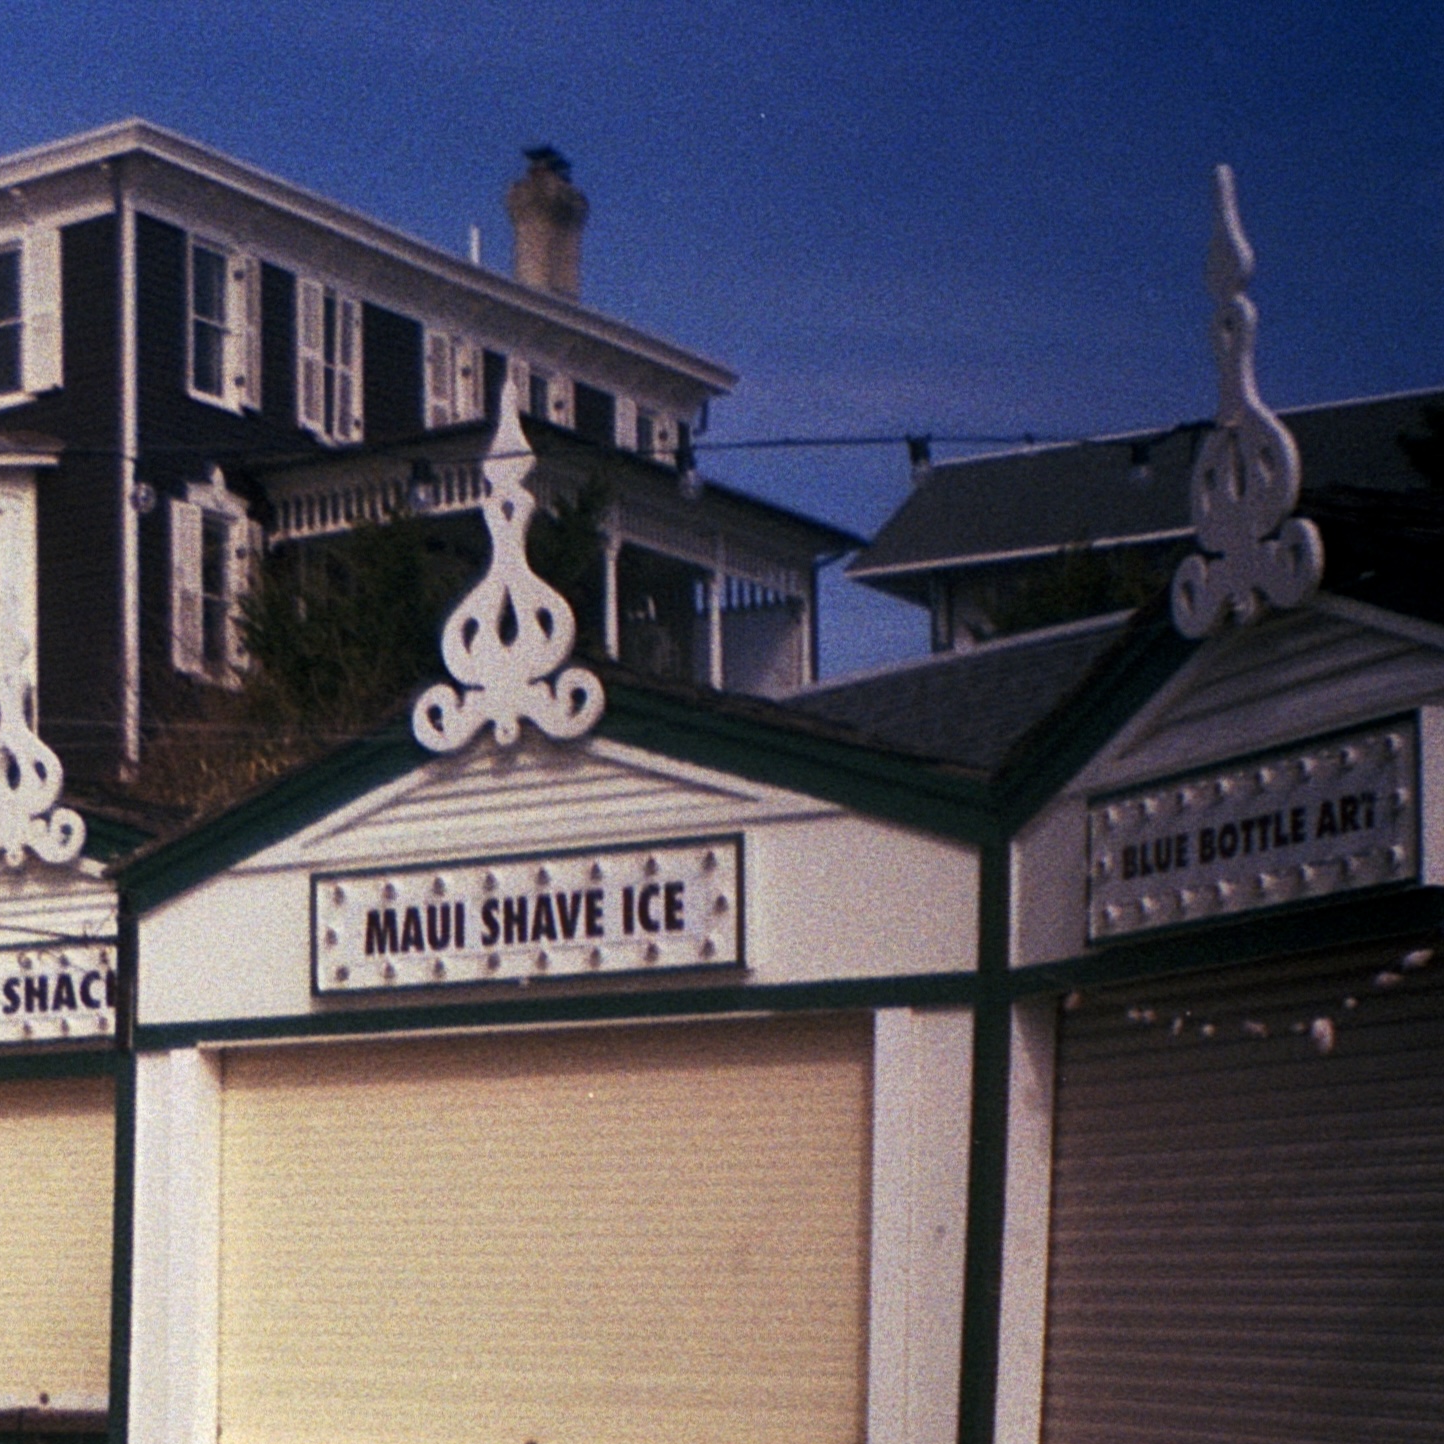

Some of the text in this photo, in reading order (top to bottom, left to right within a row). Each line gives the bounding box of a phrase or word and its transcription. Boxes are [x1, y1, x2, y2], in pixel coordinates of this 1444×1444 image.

[1122, 790, 1377, 880] BLUE BOTTLE ART
[365, 881, 685, 955] MAUI SHAVE ICE
